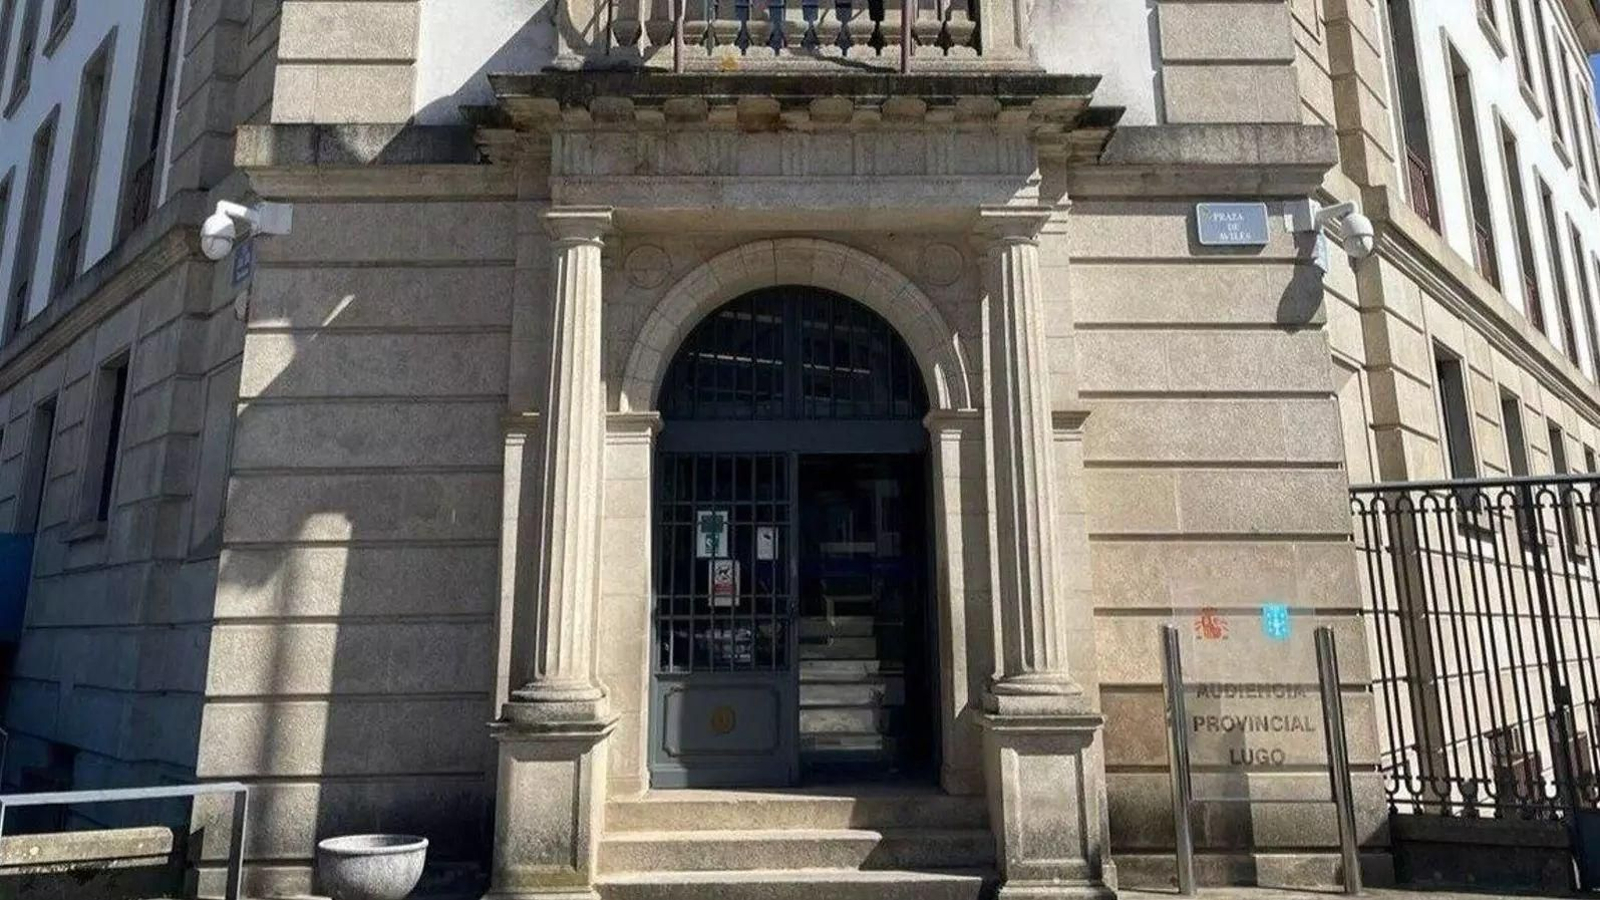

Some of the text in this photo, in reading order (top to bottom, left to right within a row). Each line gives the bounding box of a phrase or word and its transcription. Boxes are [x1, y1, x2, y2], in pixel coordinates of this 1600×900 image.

[1212, 212, 1243, 221] PRAZA
[1228, 222, 1241, 231] DE
[1197, 683, 1307, 699] AUDIENCIA
[1193, 715, 1316, 732] PROVINCIAL
[1229, 748, 1286, 766] LUGO
